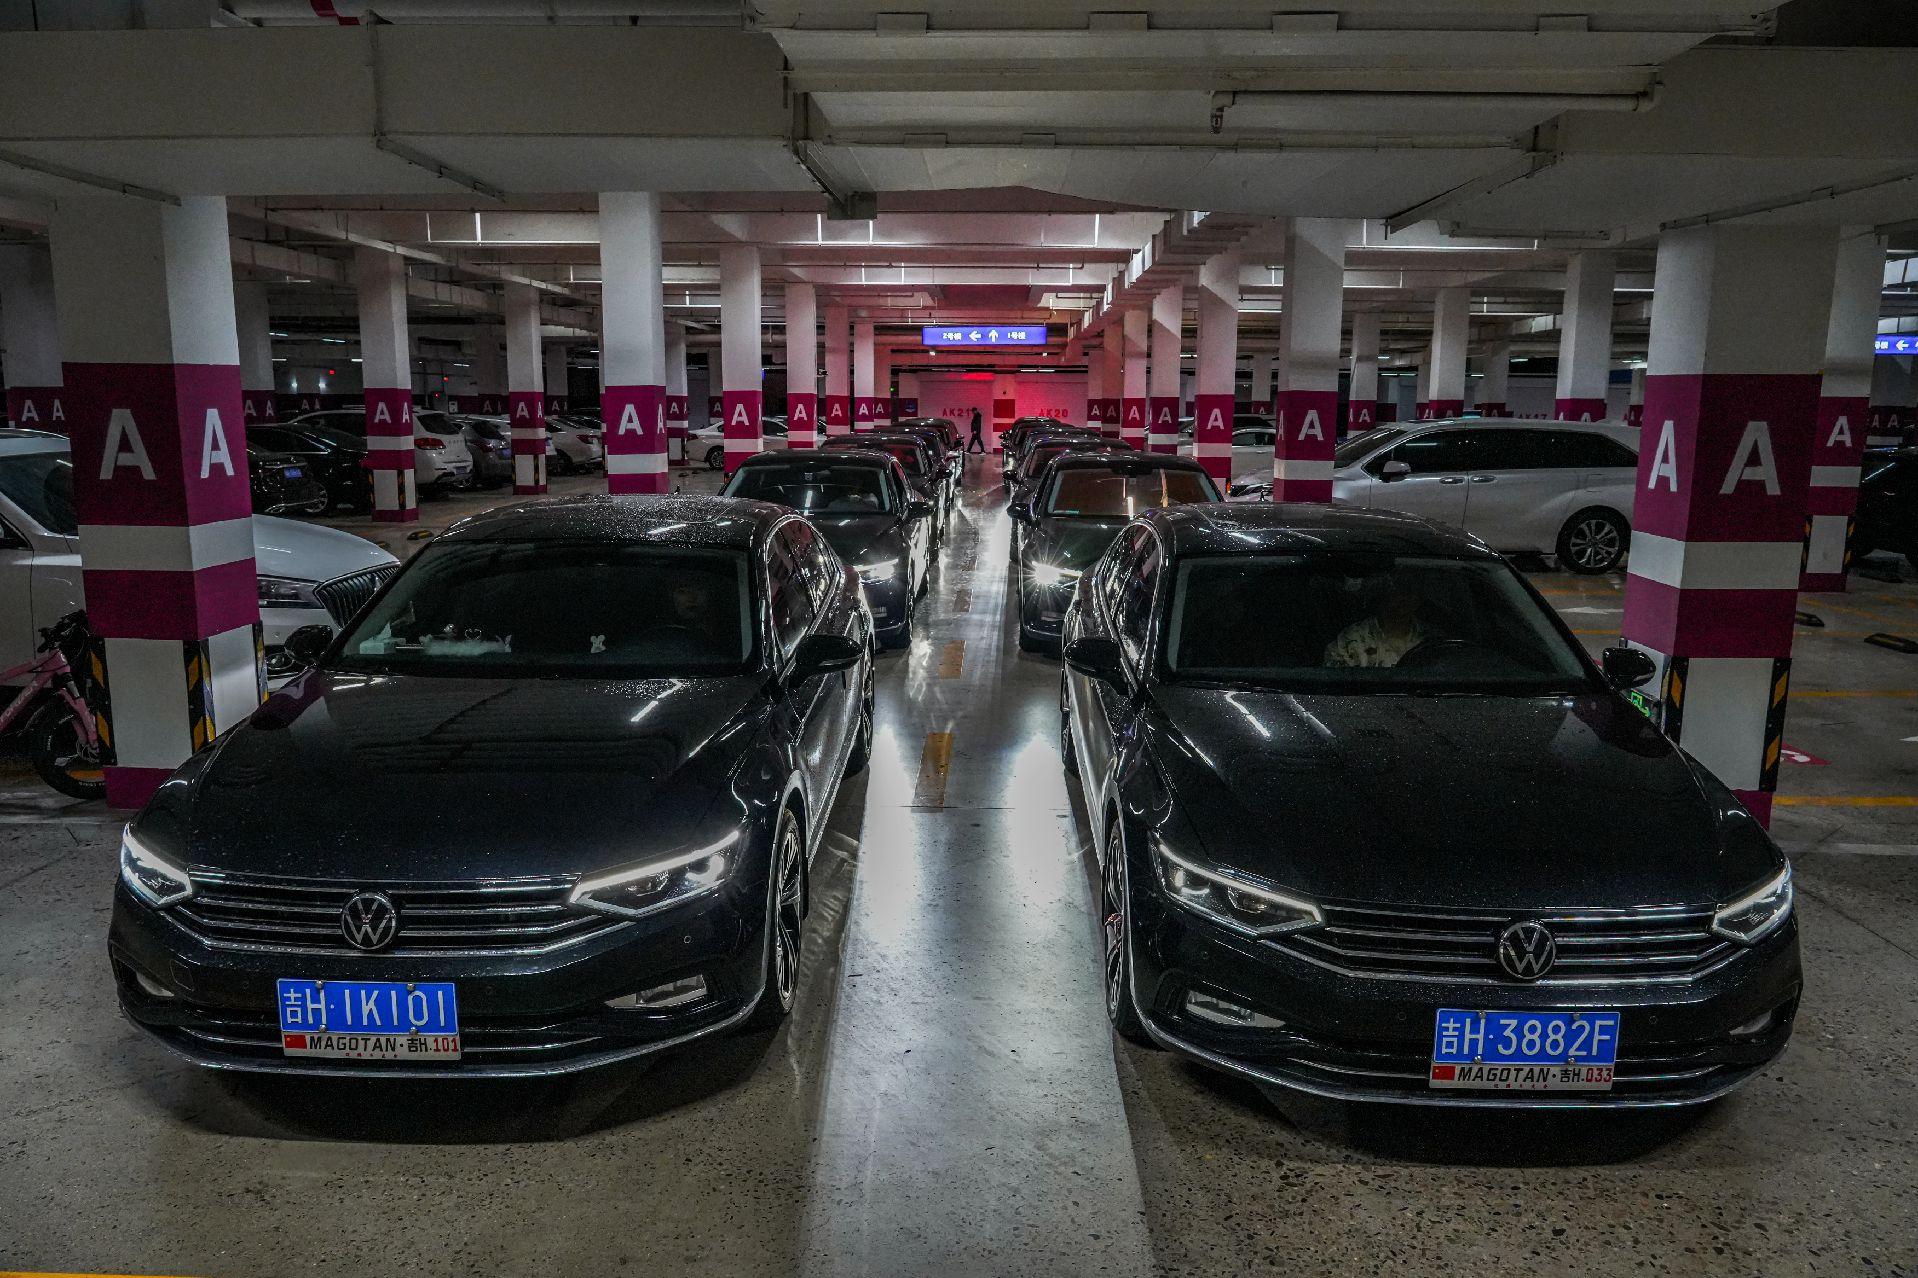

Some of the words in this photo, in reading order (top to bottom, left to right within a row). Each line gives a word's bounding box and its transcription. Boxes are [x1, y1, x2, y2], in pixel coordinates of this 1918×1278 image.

[21, 399, 40, 422] A
[52, 399, 65, 421] A
[244, 399, 257, 417] A
[265, 399, 275, 417] A
[373, 401, 392, 424] A
[402, 401, 410, 423] A
[515, 401, 530, 419] A
[537, 401, 543, 418] A
[551, 401, 560, 412] A
[669, 401, 680, 414] A
[713, 402, 722, 413] A
[731, 403, 750, 426] A
[793, 403, 808, 421] A
[830, 403, 843, 417] A
[858, 403, 869, 415] A
[875, 403, 885, 414] A
[1038, 408, 1069, 418] AK20
[1091, 404, 1101, 416] A
[1106, 405, 1117, 417] A
[1128, 405, 1141, 421] A
[1158, 406, 1172, 424] A
[1359, 408, 1371, 423] A
[618, 403, 644, 435] A
[657, 403, 665, 434] A
[1206, 408, 1225, 430] A
[1277, 409, 1285, 441] A
[1297, 409, 1324, 441] A
[1871, 414, 1880, 428] A
[1887, 414, 1900, 428] A
[1826, 415, 1853, 447] A
[99, 408, 157, 481] A
[200, 408, 235, 479] A
[1648, 420, 1678, 493] A
[1719, 421, 1782, 496] A
